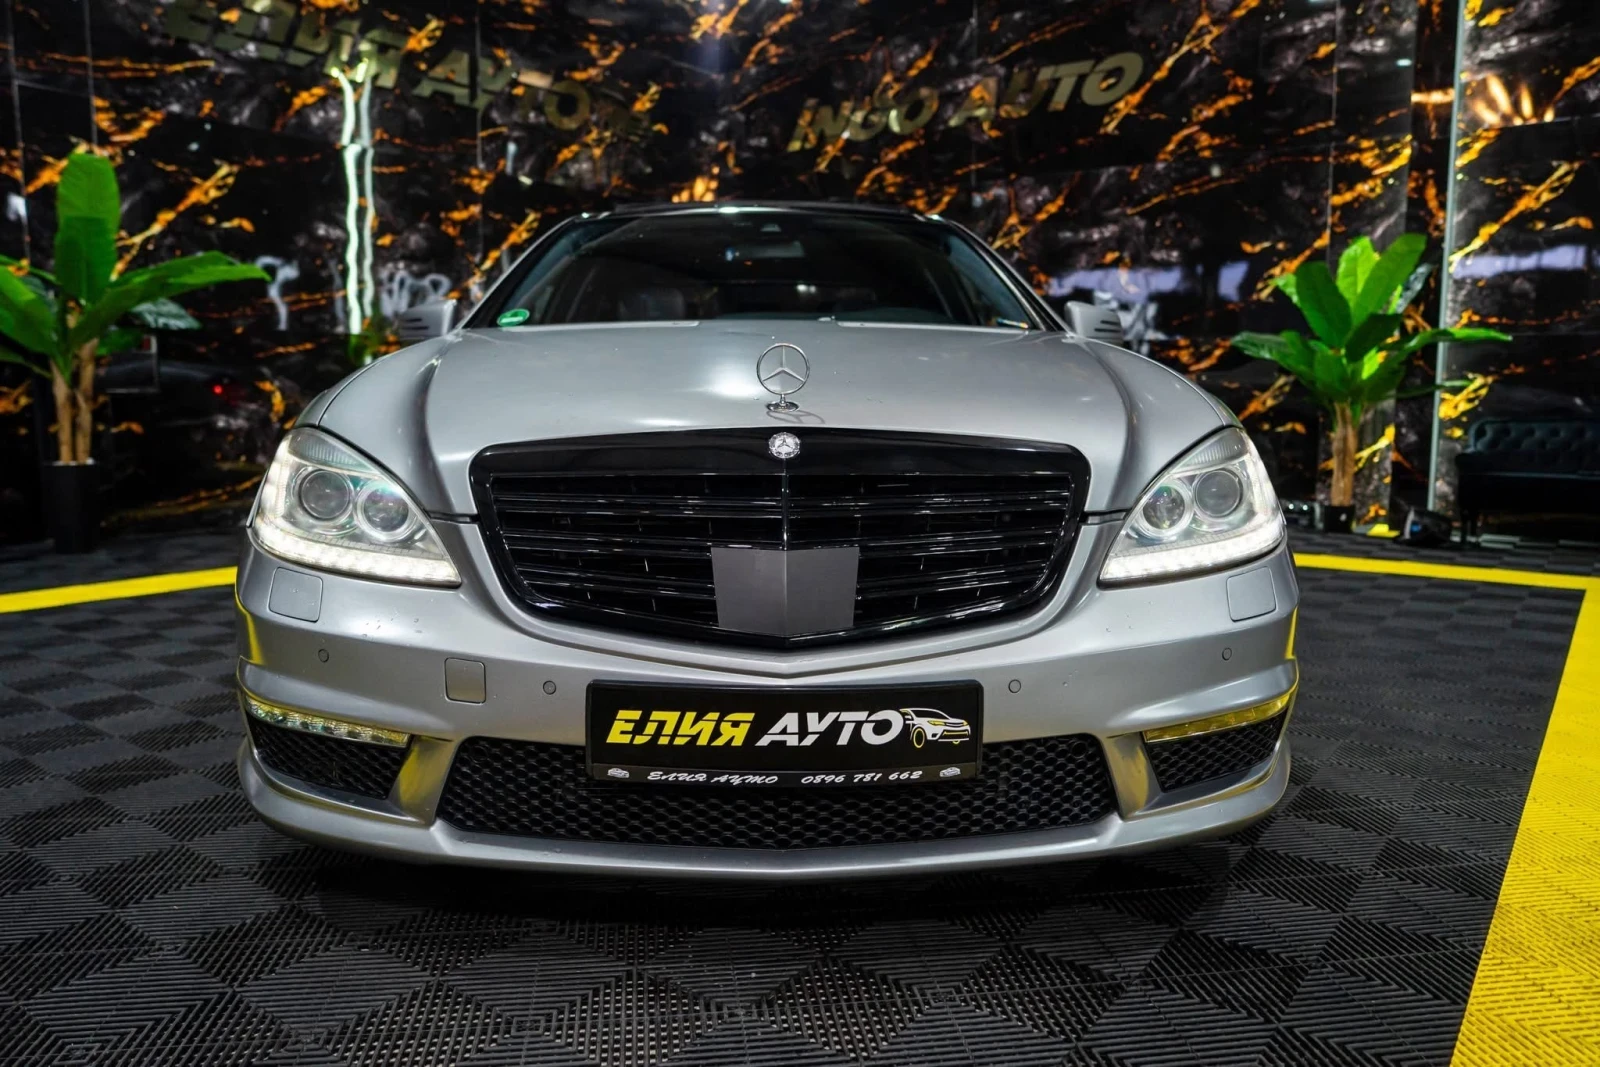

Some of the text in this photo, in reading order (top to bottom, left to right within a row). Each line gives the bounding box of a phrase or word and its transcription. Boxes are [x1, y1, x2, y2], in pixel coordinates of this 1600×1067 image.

[947, 51, 1144, 130] AUTO
[606, 709, 904, 746] ЕЛИЯ АУТО
[801, 774, 846, 784] 0896
[853, 772, 882, 783] 781
[888, 770, 923, 780] 662
